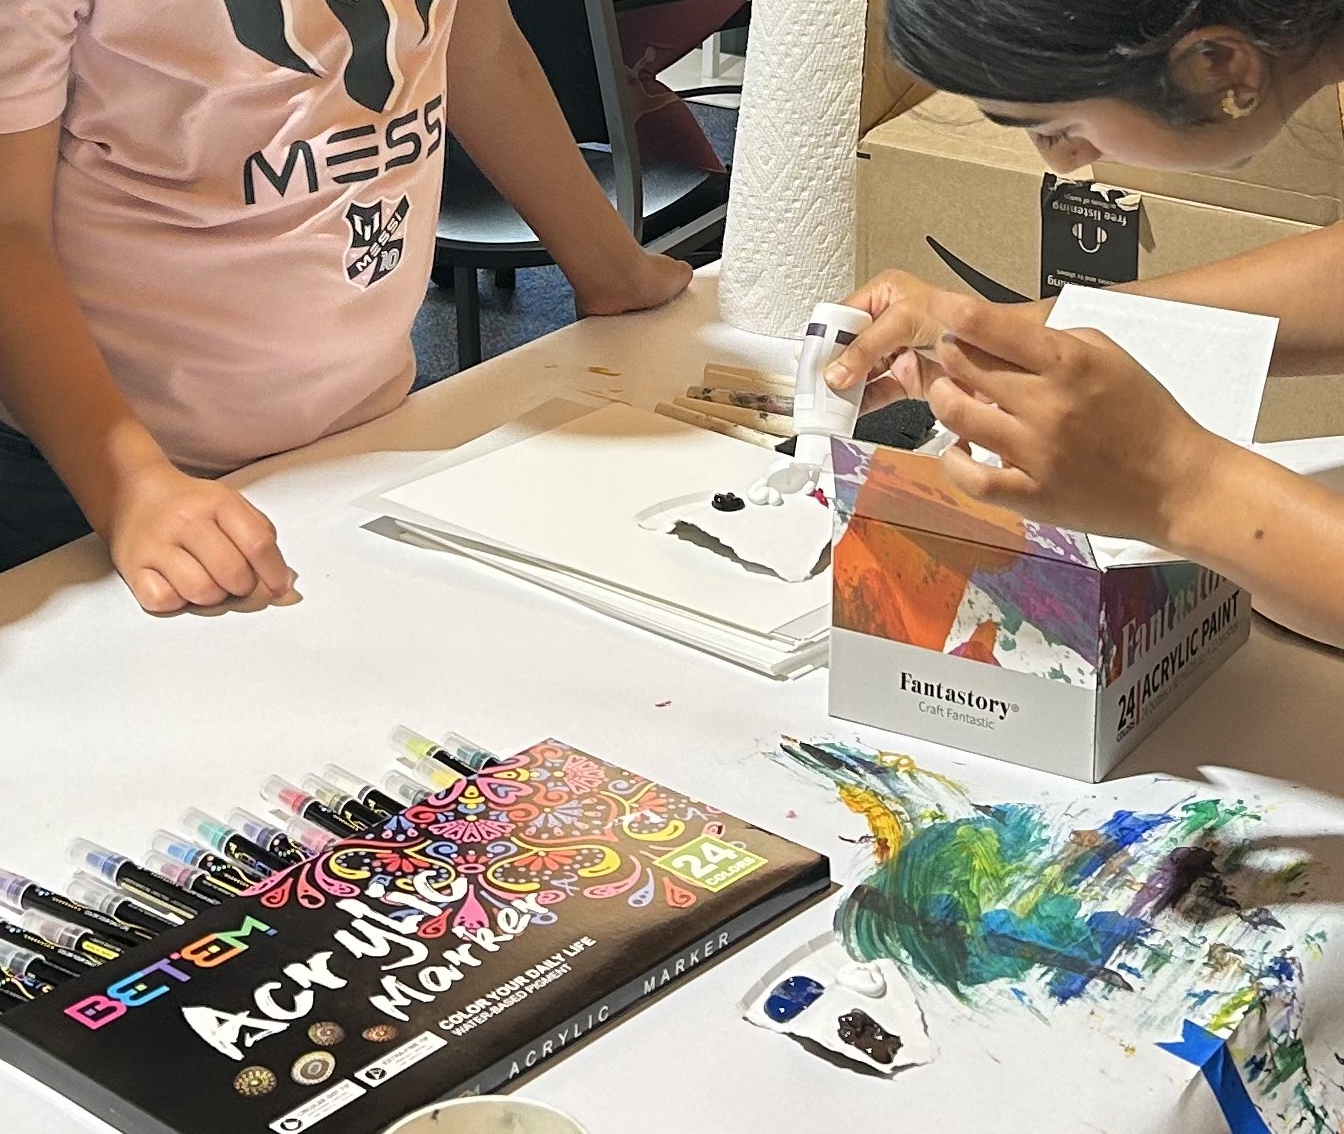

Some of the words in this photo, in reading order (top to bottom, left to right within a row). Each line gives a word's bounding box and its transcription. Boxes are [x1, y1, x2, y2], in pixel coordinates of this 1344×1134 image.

[243, 93, 447, 206] MESS
[1052, 200, 1101, 221] listening
[1104, 210, 1127, 227] free
[355, 215, 403, 271] MESSI
[380, 247, 400, 272] 10
[1118, 686, 1136, 731] 24
[1142, 628, 1198, 704] ACRYLIC
[1201, 589, 1240, 647] PAINT
[918, 701, 945, 718] Craft
[946, 708, 996, 730] Fantastic
[672, 841, 738, 879] 24
[705, 856, 756, 886] COLORS
[438, 997, 492, 1030] COLOR
[485, 975, 531, 1001] YOUR
[524, 952, 566, 979] DAILY
[562, 935, 597, 957] LIFE
[450, 989, 529, 1037] WATER-BASED
[508, 1004, 610, 1080] ACRYLIC
[643, 931, 730, 995] MARKER
